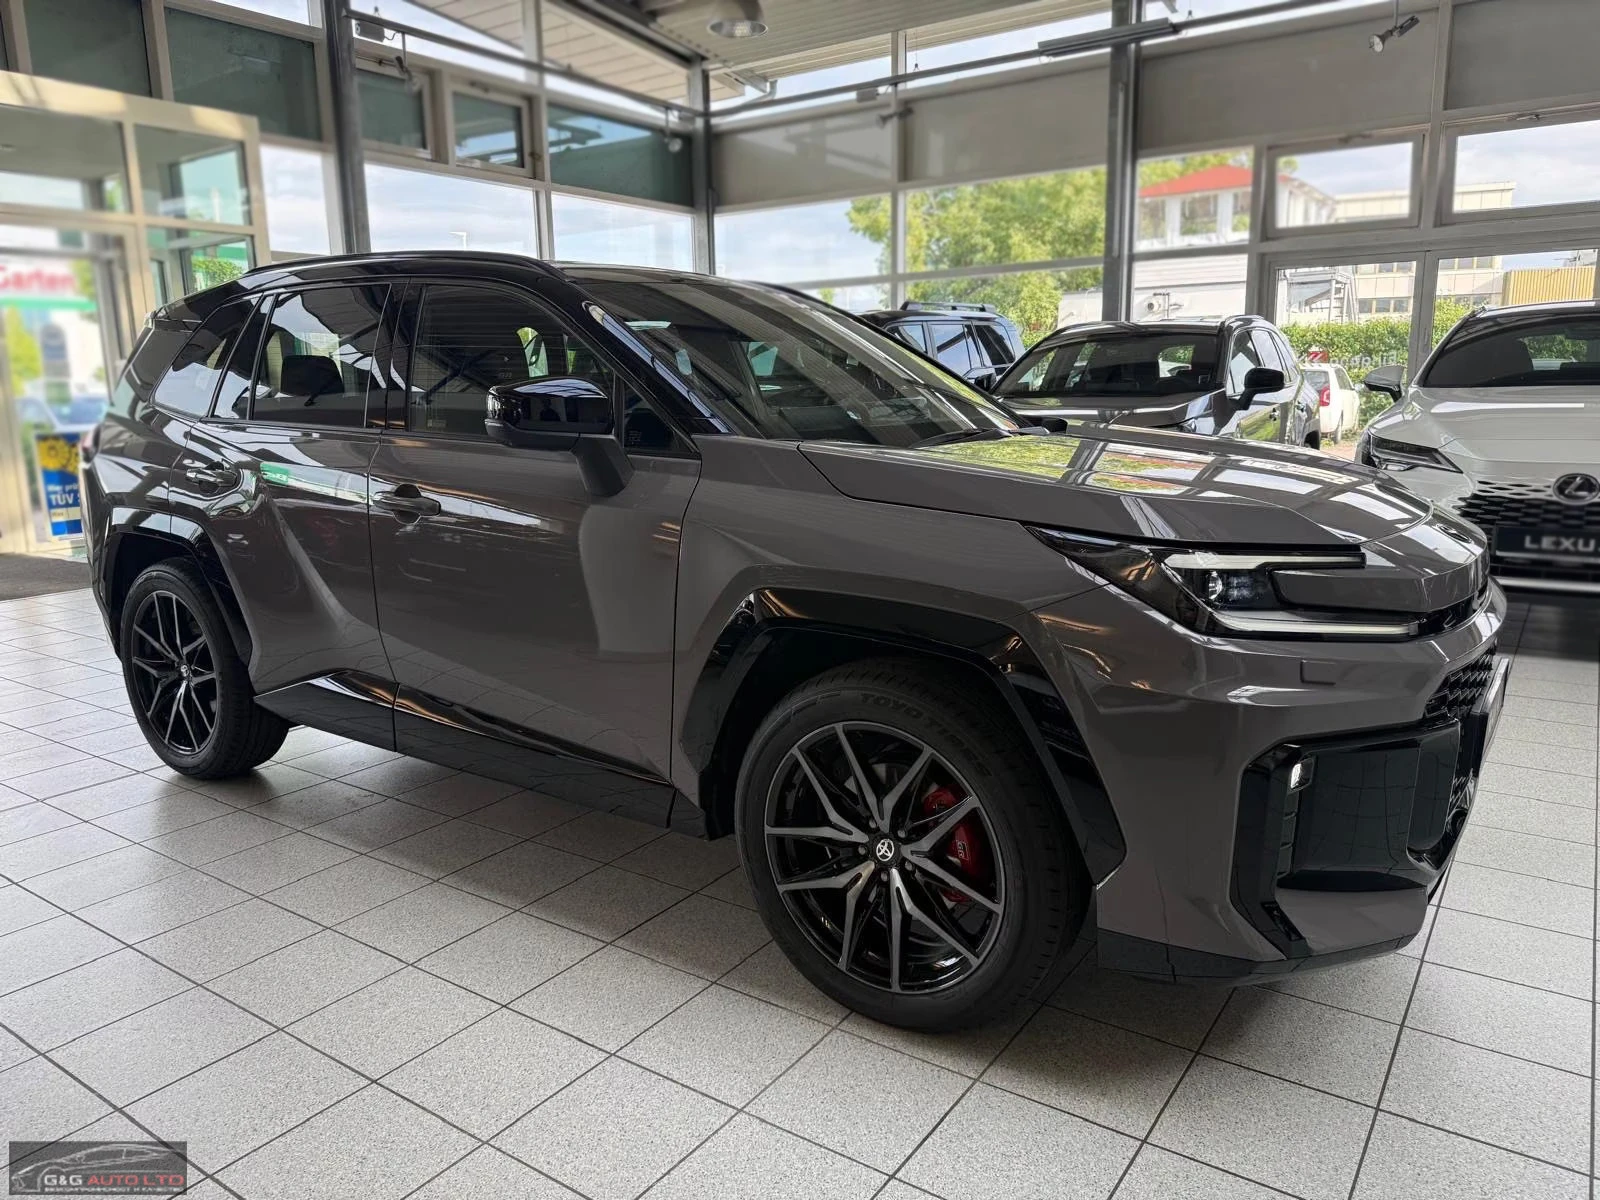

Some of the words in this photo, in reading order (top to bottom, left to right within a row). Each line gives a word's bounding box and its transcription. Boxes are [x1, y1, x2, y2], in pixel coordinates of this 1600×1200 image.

[49, 491, 74, 506] TÜV
[1524, 535, 1600, 552] LEXU
[861, 693, 925, 720] TOYO
